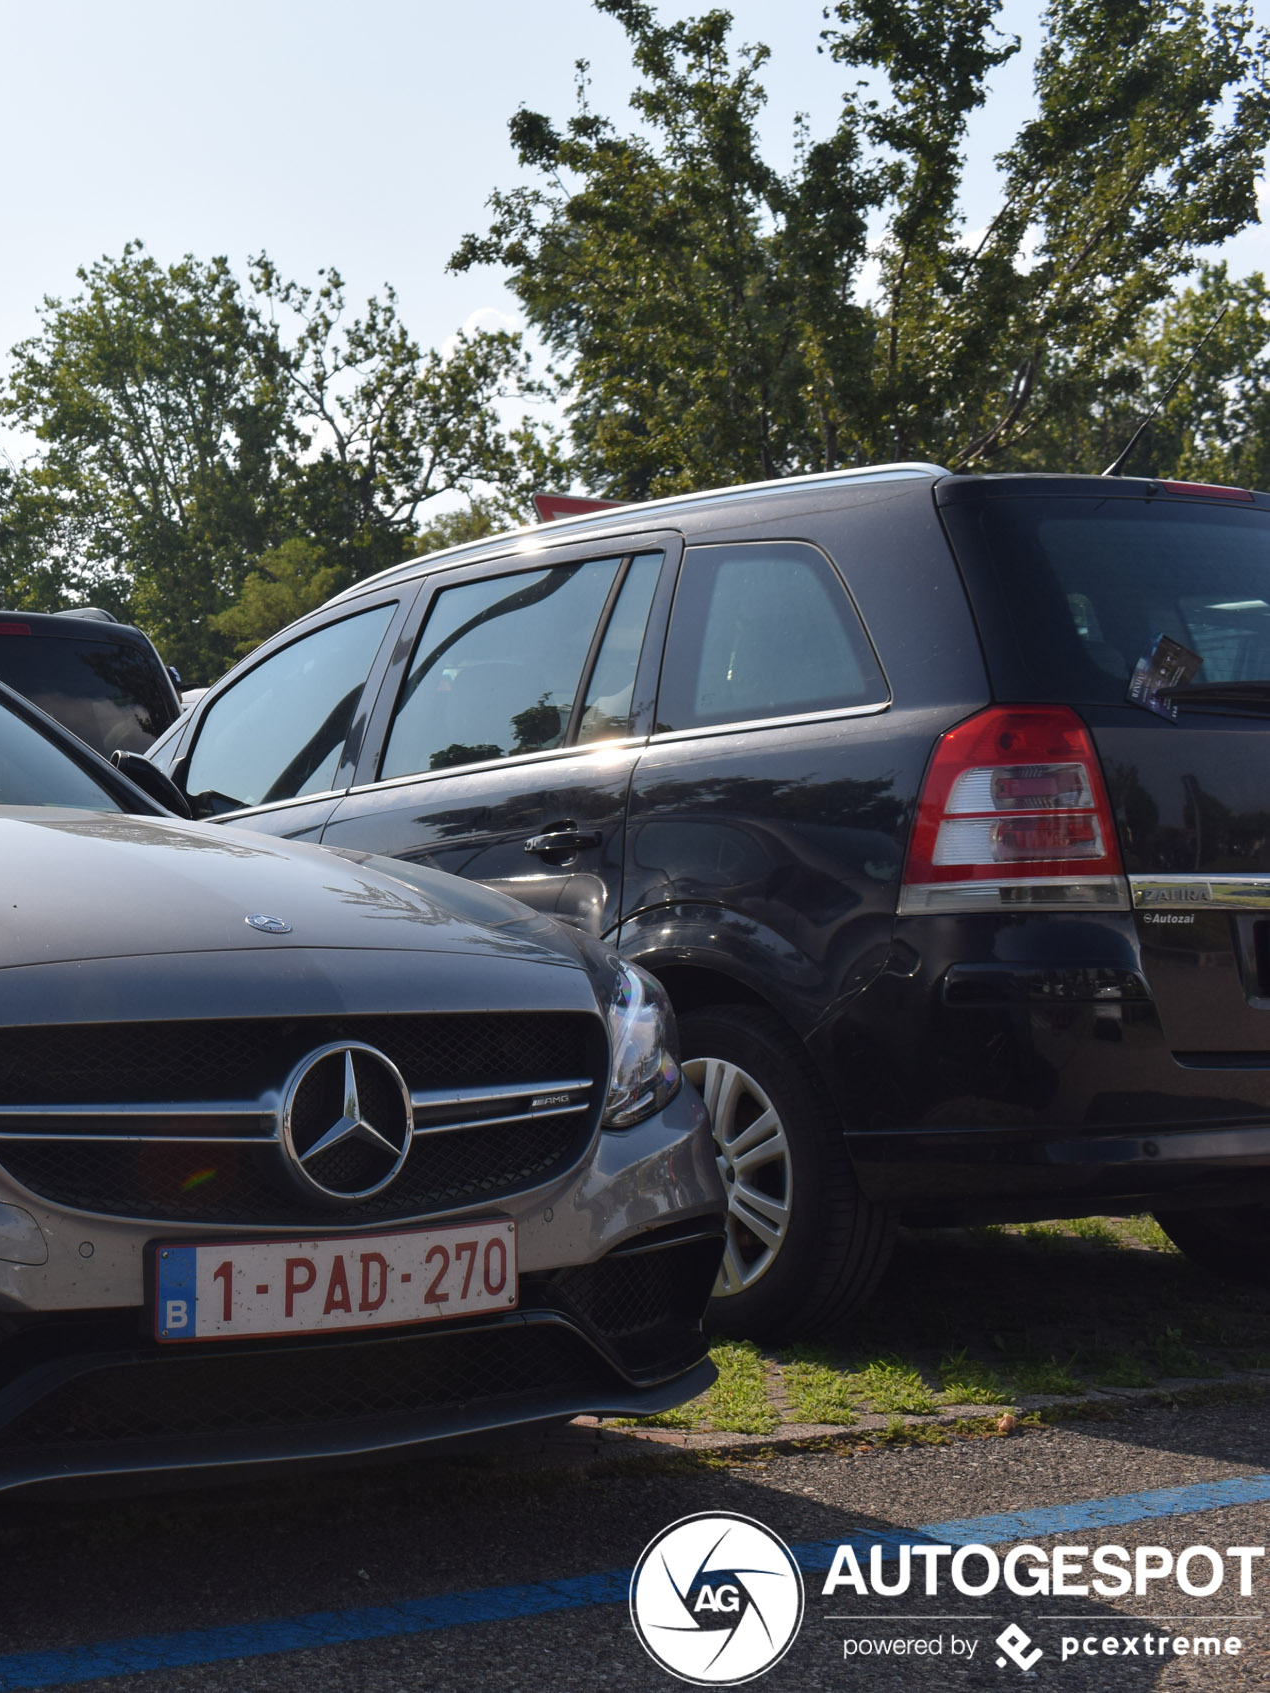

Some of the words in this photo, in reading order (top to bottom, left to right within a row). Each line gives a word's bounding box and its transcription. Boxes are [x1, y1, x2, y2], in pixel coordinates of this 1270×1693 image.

[1152, 913, 1195, 923] Autozai
[544, 1095, 570, 1105] AMG
[213, 1237, 508, 1322] 1-PAD-270
[166, 1300, 188, 1328] B
